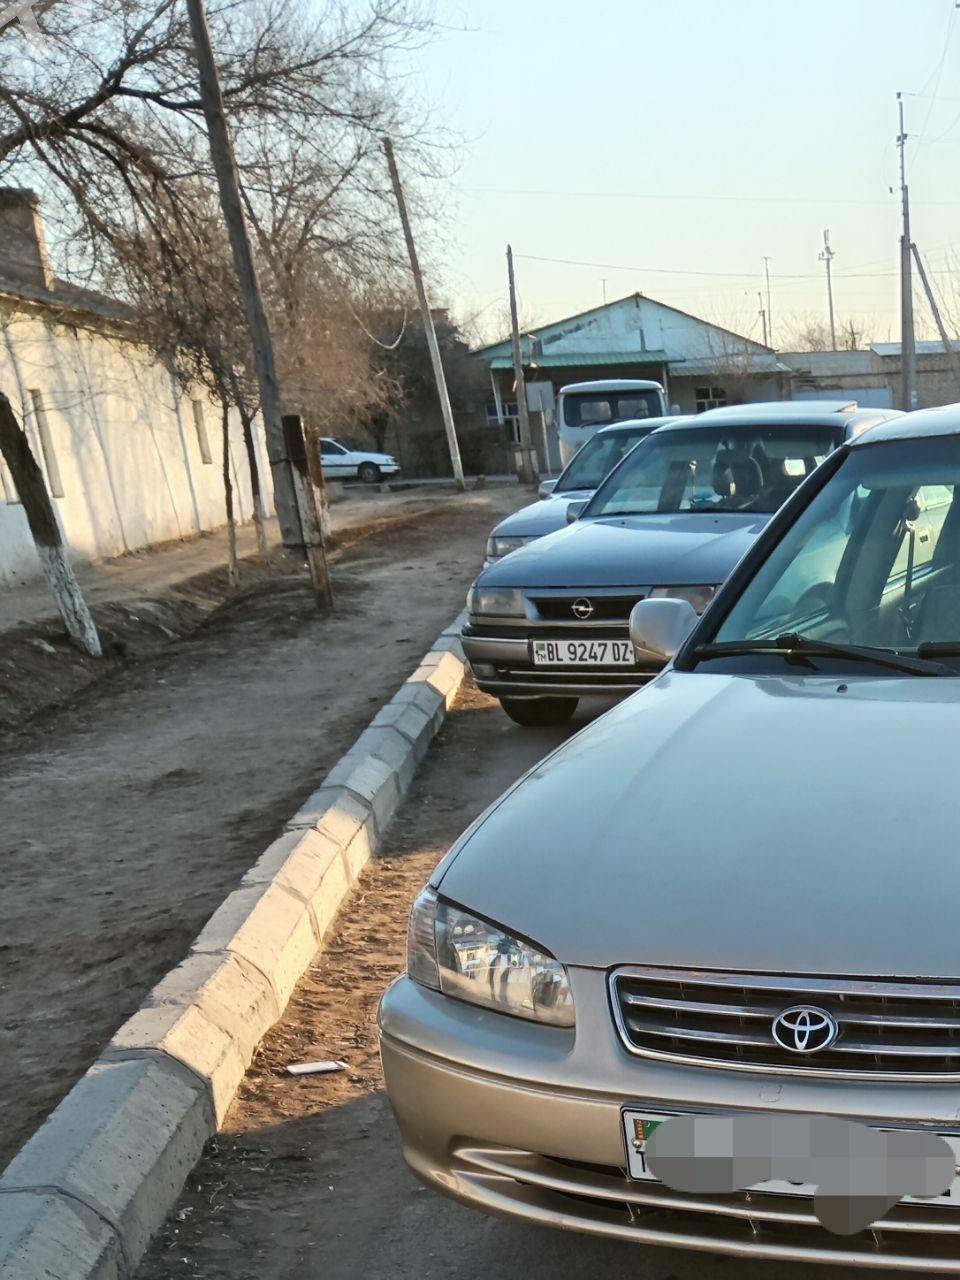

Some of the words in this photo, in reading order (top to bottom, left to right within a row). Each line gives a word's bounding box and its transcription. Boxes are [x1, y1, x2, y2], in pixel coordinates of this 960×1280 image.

[547, 643, 563, 661] BL
[567, 643, 607, 661] 9247
[612, 643, 630, 661] DZ
